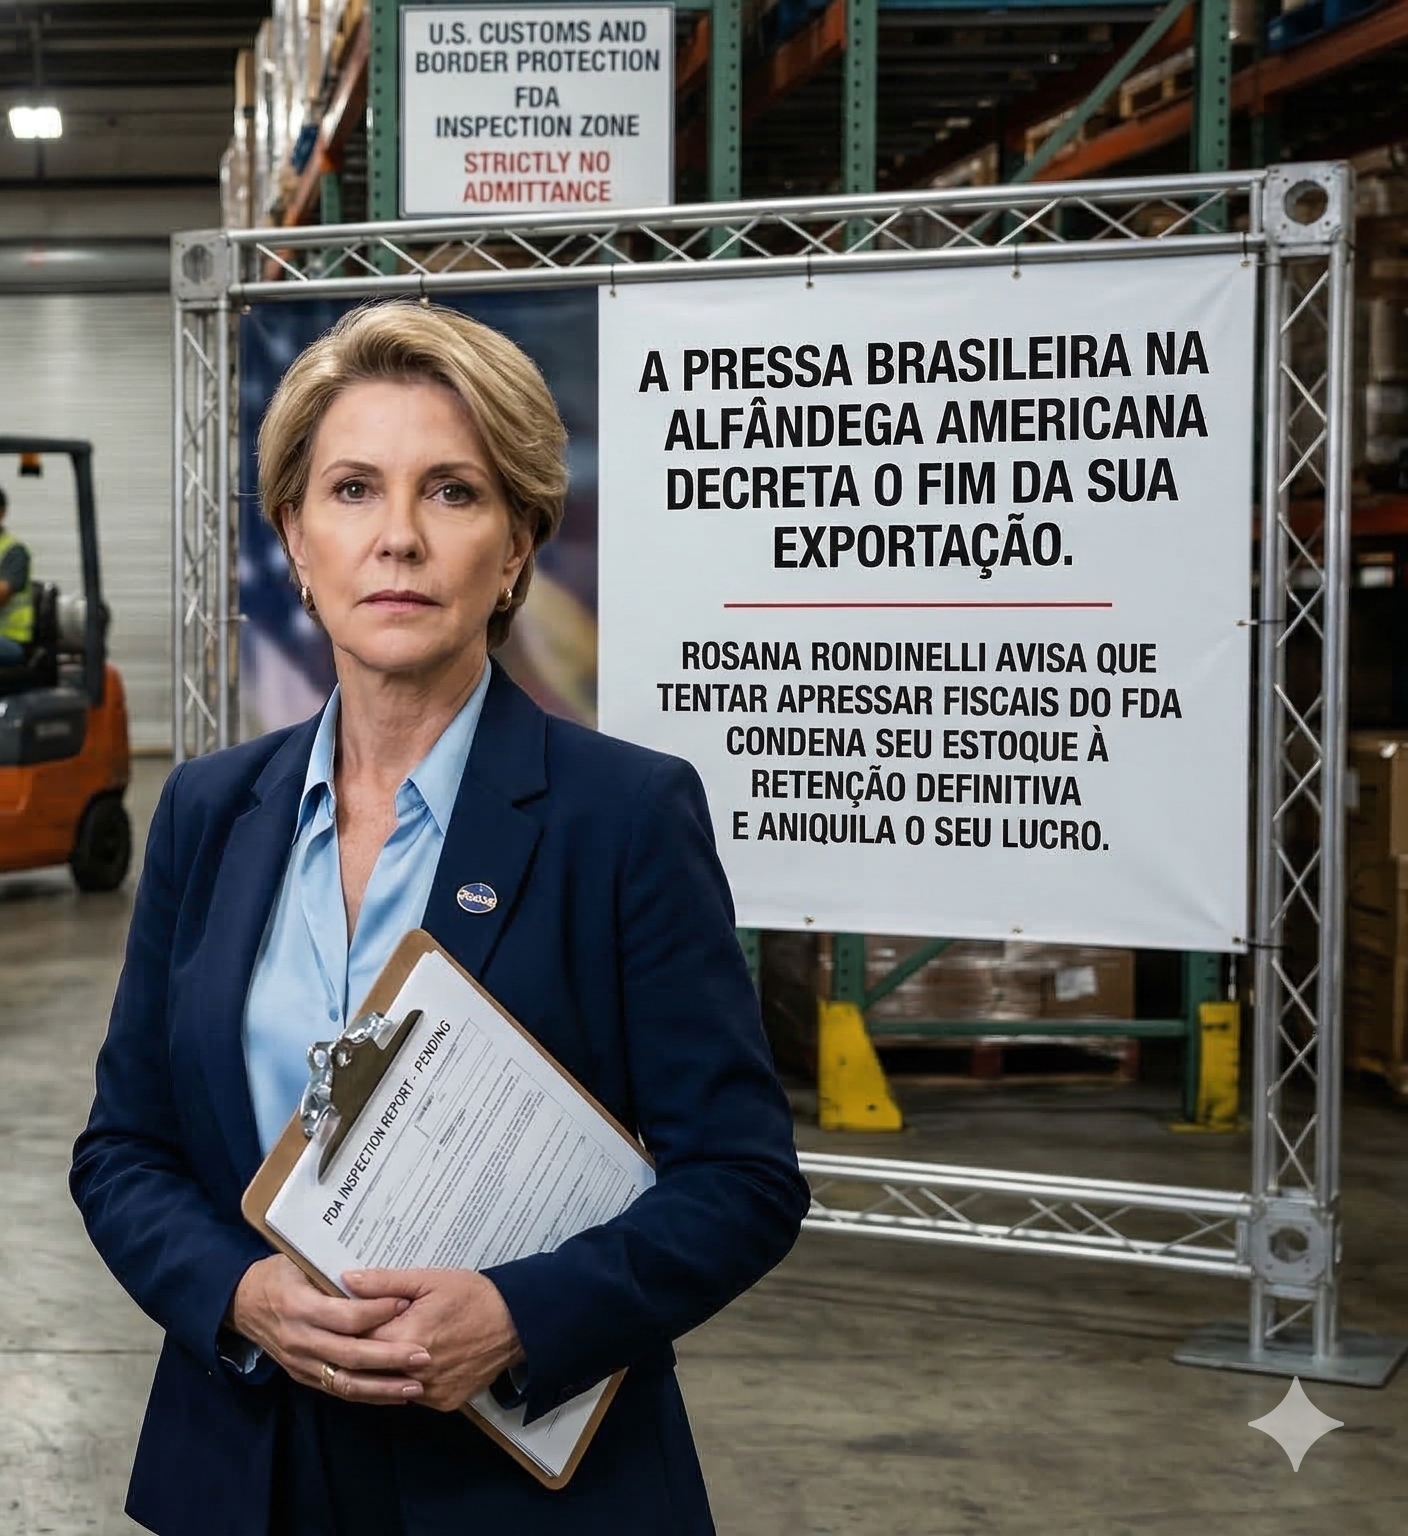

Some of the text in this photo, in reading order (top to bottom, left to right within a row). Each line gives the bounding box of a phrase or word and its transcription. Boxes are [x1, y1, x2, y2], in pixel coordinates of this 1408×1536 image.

[430, 21, 646, 44] U.S. CUSTOMS AND
[415, 50, 660, 73] BORDER PROTECTION
[514, 86, 560, 108] FDA
[436, 115, 639, 138] INSPECTION ZONE
[464, 150, 610, 174] STRICTLY NO
[463, 180, 611, 203] ADMITTANCE
[639, 331, 1209, 393] A PRESSA BRASILEIRA NA
[665, 393, 1208, 451] ALFÂNDEGA AMERICANA
[666, 458, 1179, 510] DECRETA O FIM DA SUA
[773, 513, 1072, 579] EXPORTAÇÃO.
[681, 640, 1156, 676] ROSANA RONDINELLI AVISA QUE
[657, 683, 1181, 719] TENTAR APRESSAR FISCAIS DO FDA
[726, 725, 1109, 765] CONDENA SEU ESTOQUE À
[751, 765, 1081, 808] RETENÇÃO DEFINITIVA
[733, 811, 1109, 851] E ANIQUILA O SEU LUCRO.
[322, 1199, 346, 1226] FDA
[338, 1126, 387, 1201] INSPECTION
[381, 1079, 414, 1129] REPORT
[414, 1019, 452, 1073] PENDING
